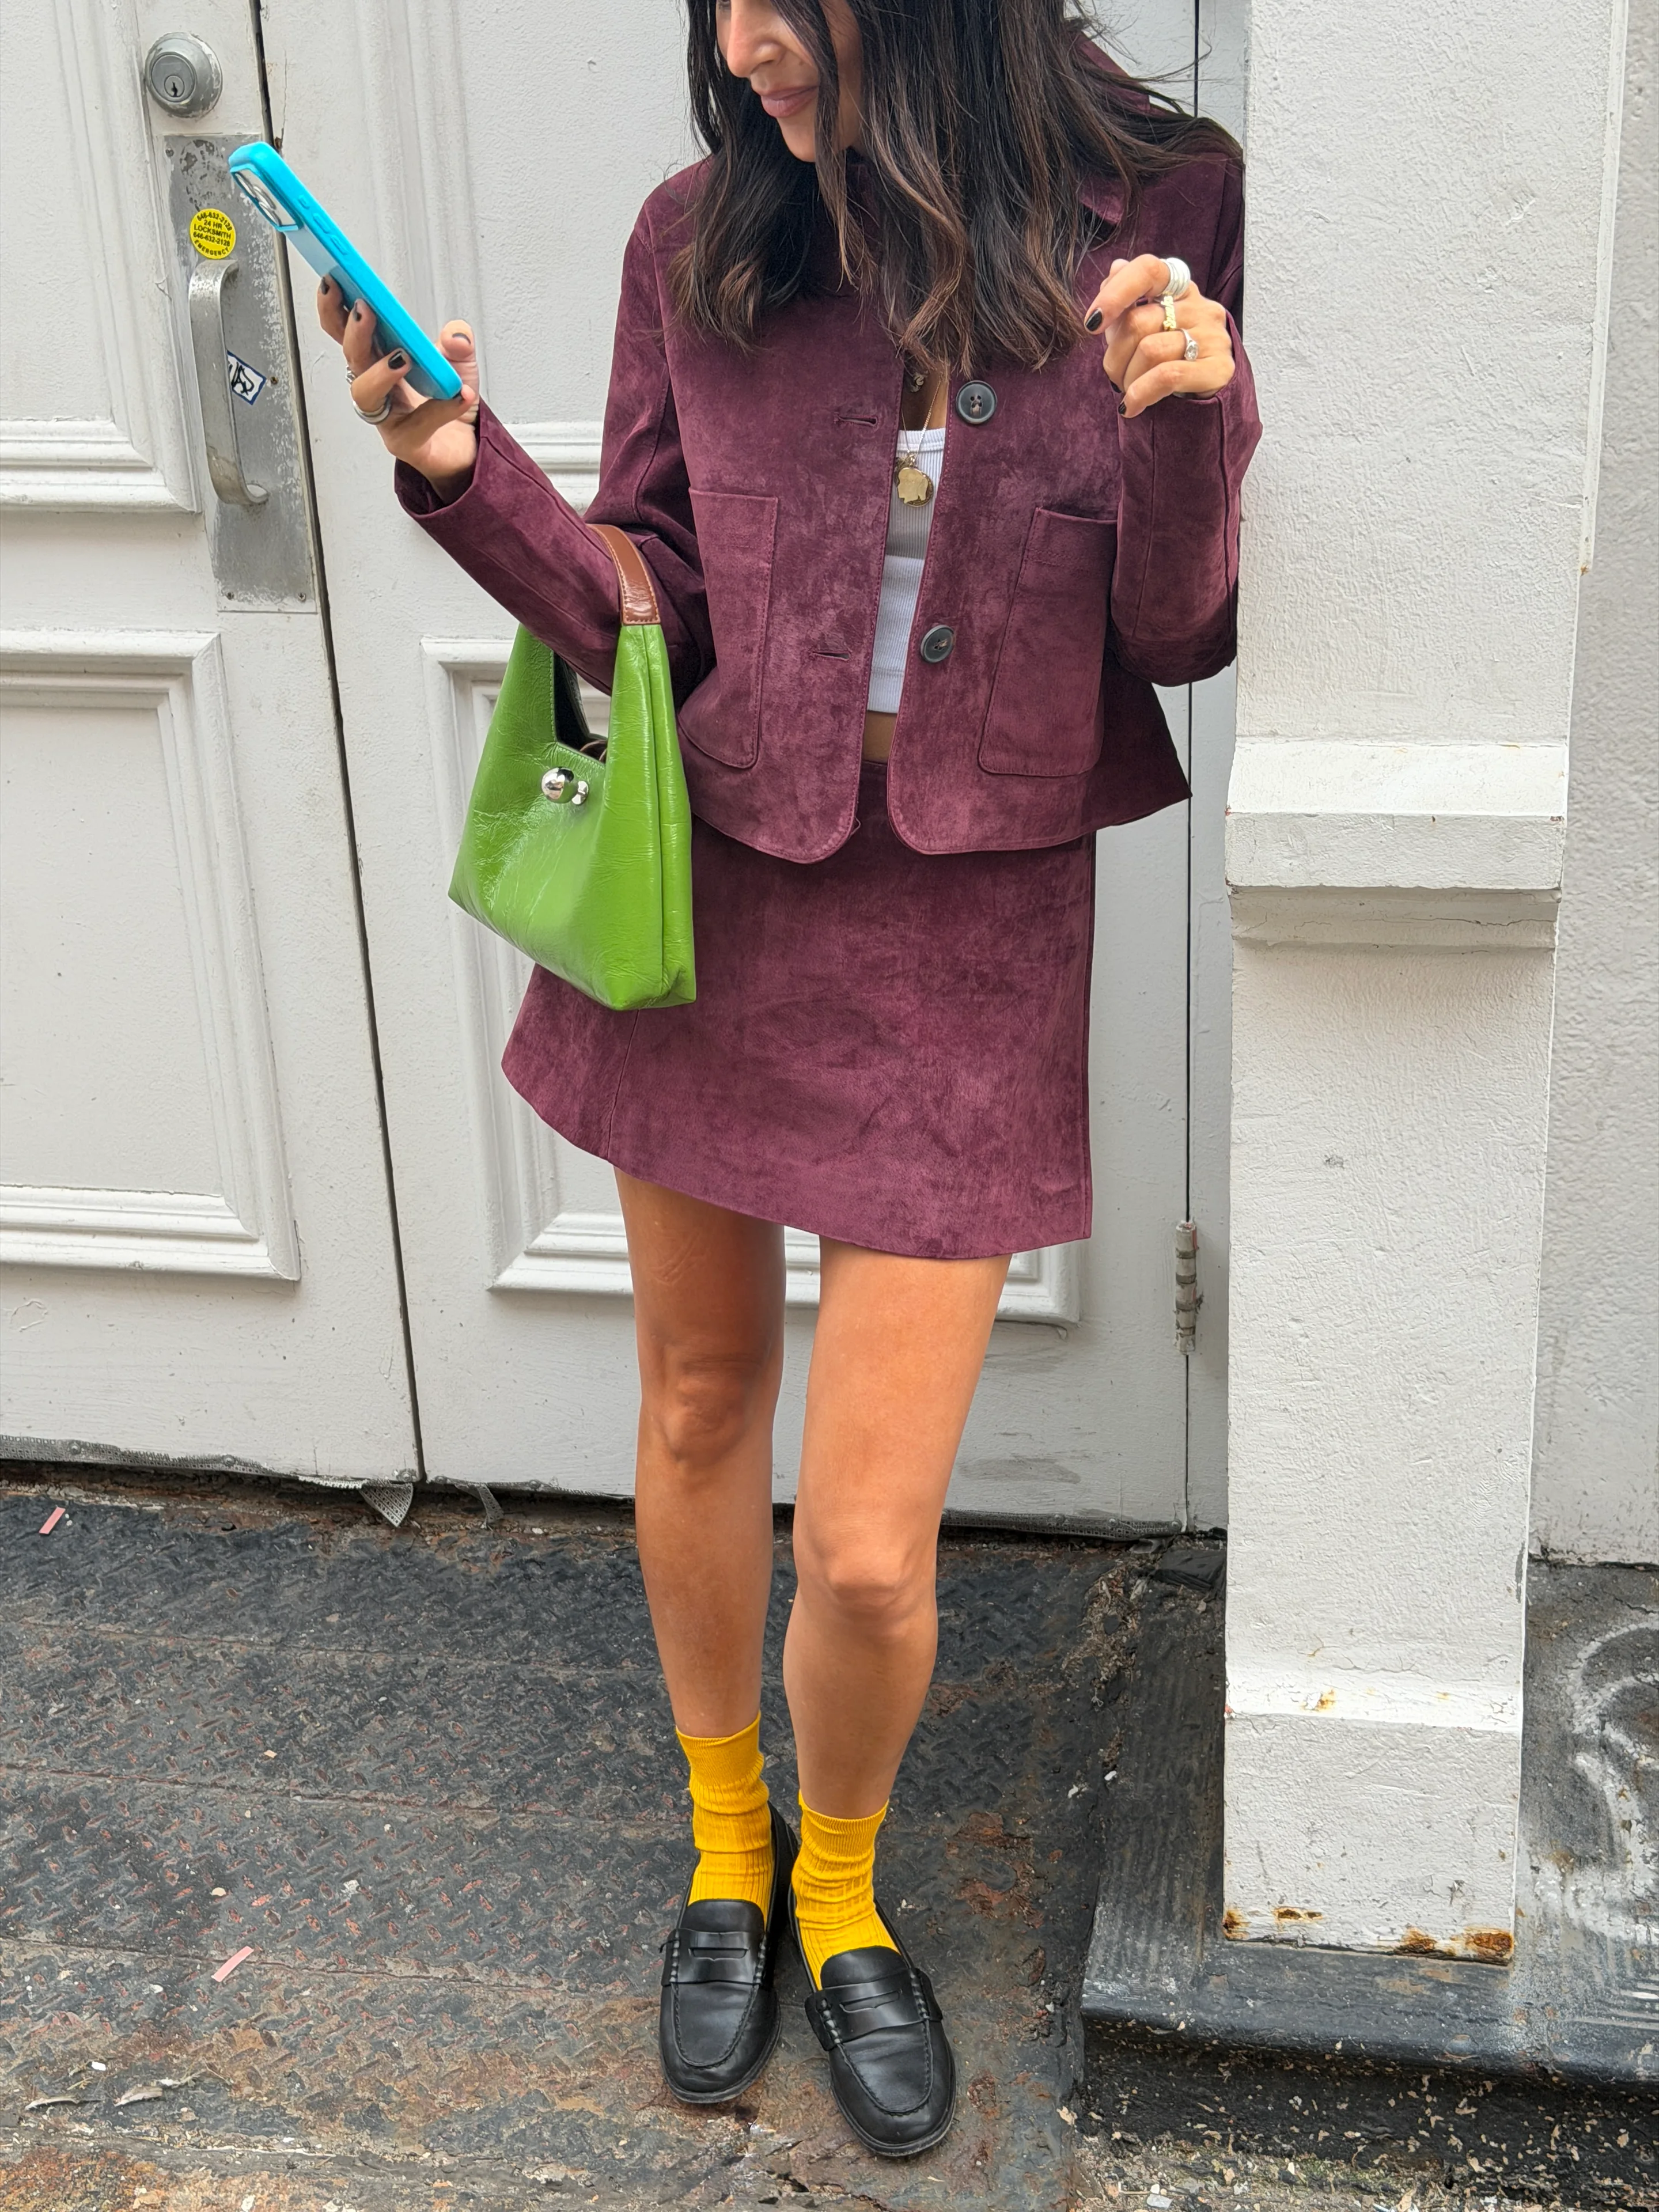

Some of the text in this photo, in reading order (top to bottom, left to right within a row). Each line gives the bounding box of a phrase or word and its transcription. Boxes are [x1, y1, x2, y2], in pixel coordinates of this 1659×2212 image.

[194, 224, 231, 239] LOCKSMITH
[213, 221, 222, 229] HR
[194, 239, 229, 256] EMERGENCY
